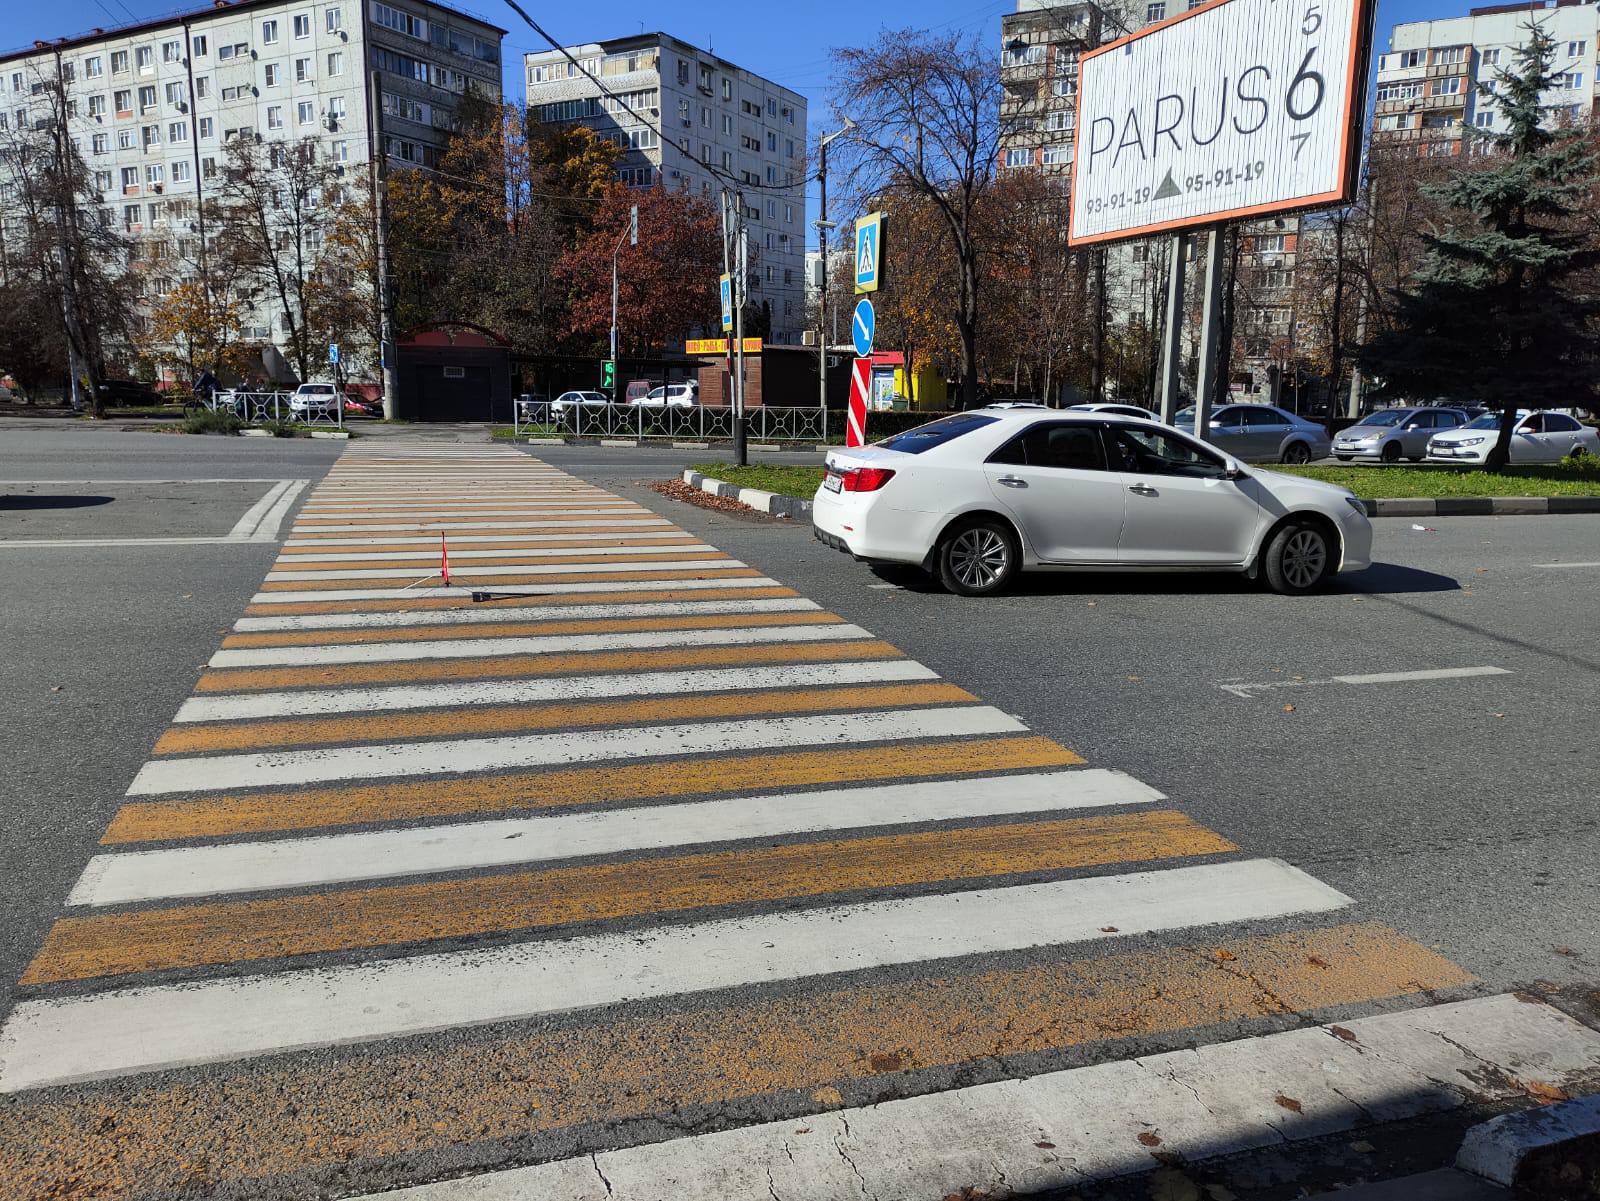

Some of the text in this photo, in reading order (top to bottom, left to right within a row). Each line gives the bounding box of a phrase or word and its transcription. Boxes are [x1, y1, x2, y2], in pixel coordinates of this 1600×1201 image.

[1301, 5, 1322, 35] 5
[1088, 46, 1325, 174] PARUS 6
[1289, 131, 1312, 161] 7
[1086, 187, 1151, 215] 93-91-19
[1185, 160, 1265, 194] 95-91-19
